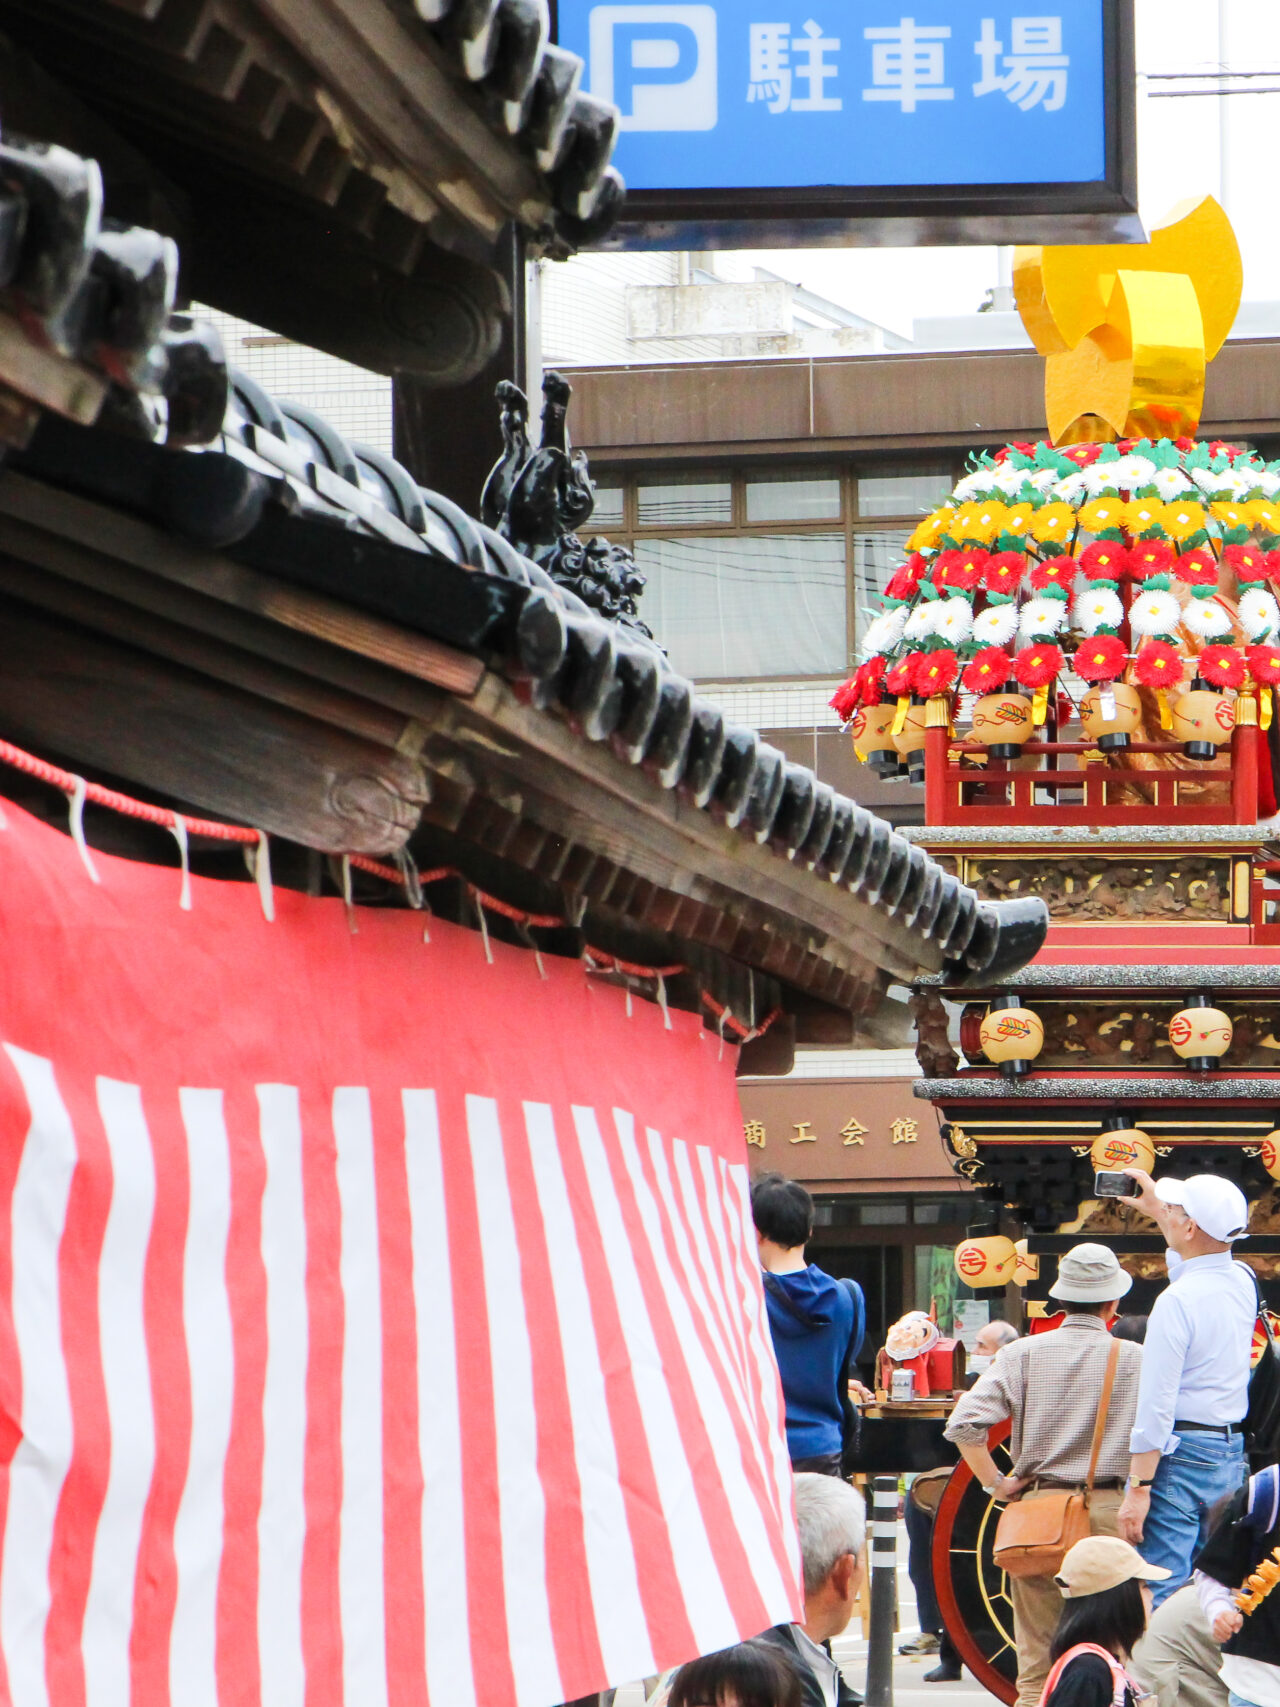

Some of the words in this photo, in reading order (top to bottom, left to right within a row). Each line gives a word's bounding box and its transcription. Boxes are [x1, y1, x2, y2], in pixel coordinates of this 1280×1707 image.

[612, 22, 699, 117] P
[746, 16, 1070, 115] 駐車場
[743, 1117, 919, 1149] 商工会館
